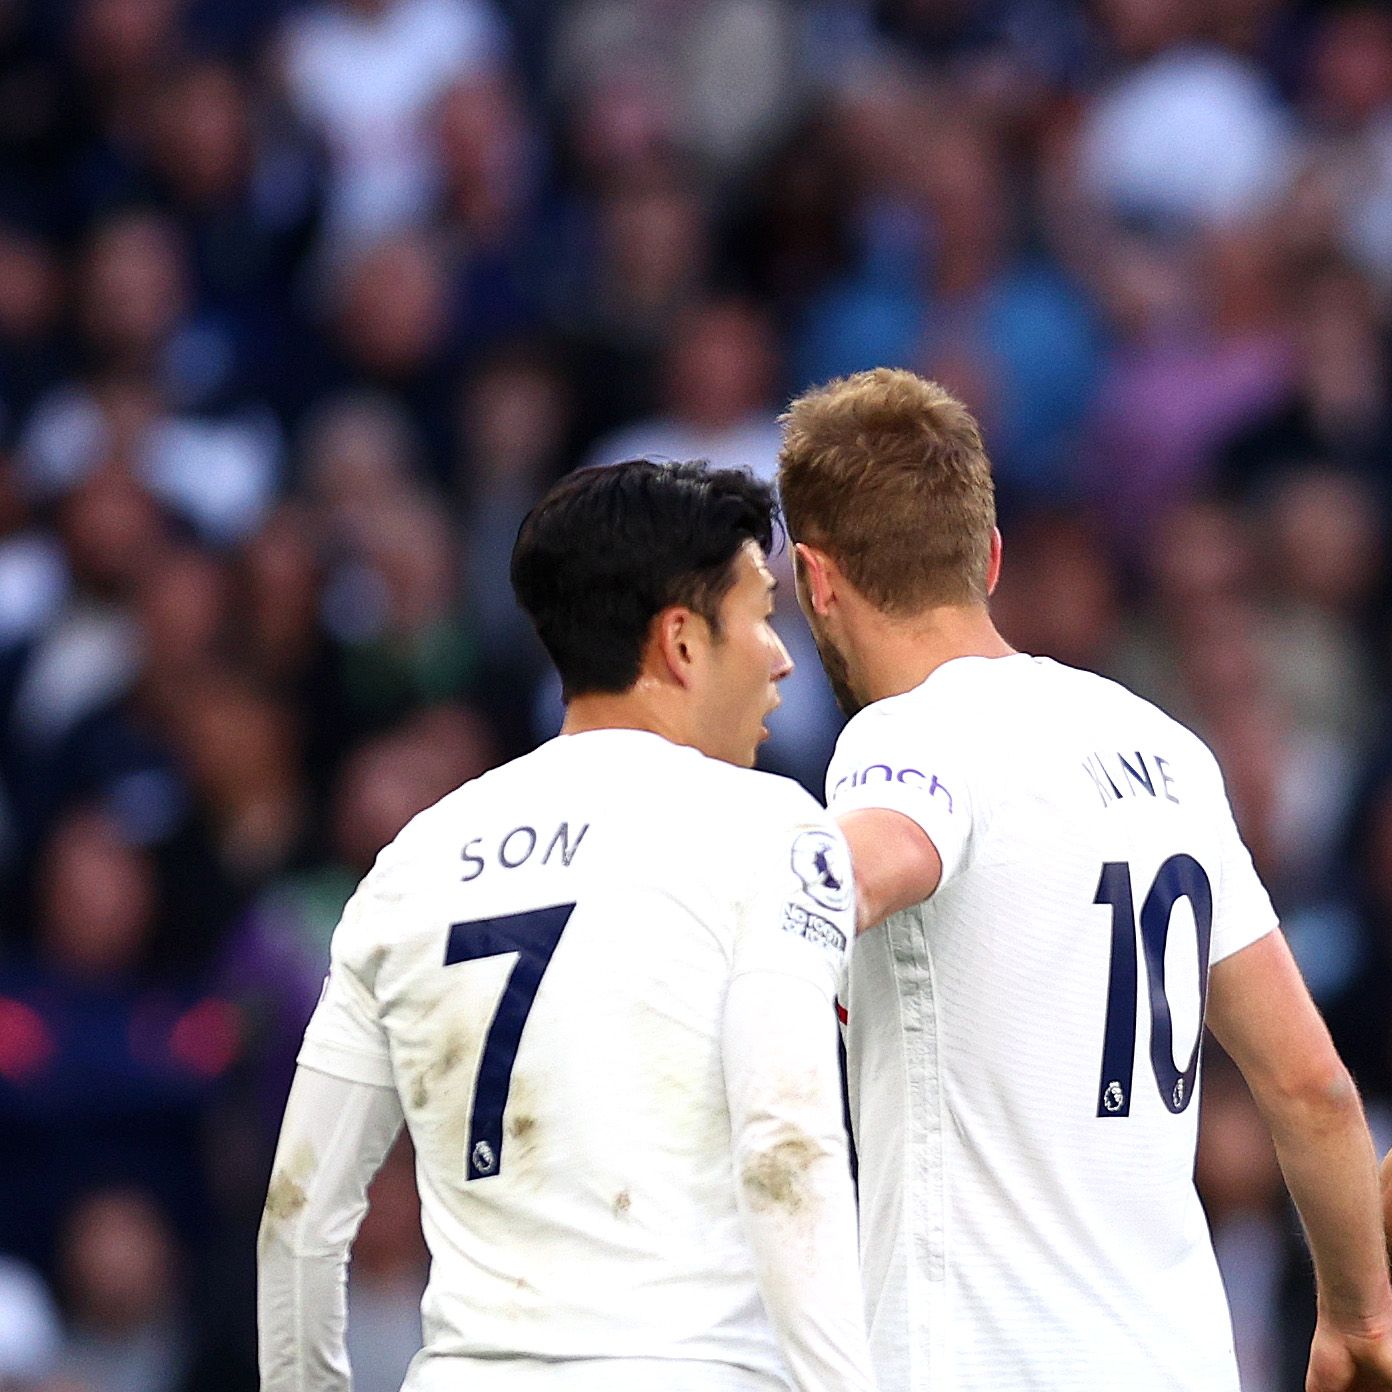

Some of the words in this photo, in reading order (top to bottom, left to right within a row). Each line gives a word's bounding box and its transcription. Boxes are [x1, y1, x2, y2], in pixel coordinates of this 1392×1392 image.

[460, 822, 590, 882] SON
[442, 900, 577, 1181] 7
[1092, 853, 1213, 1118] 10
